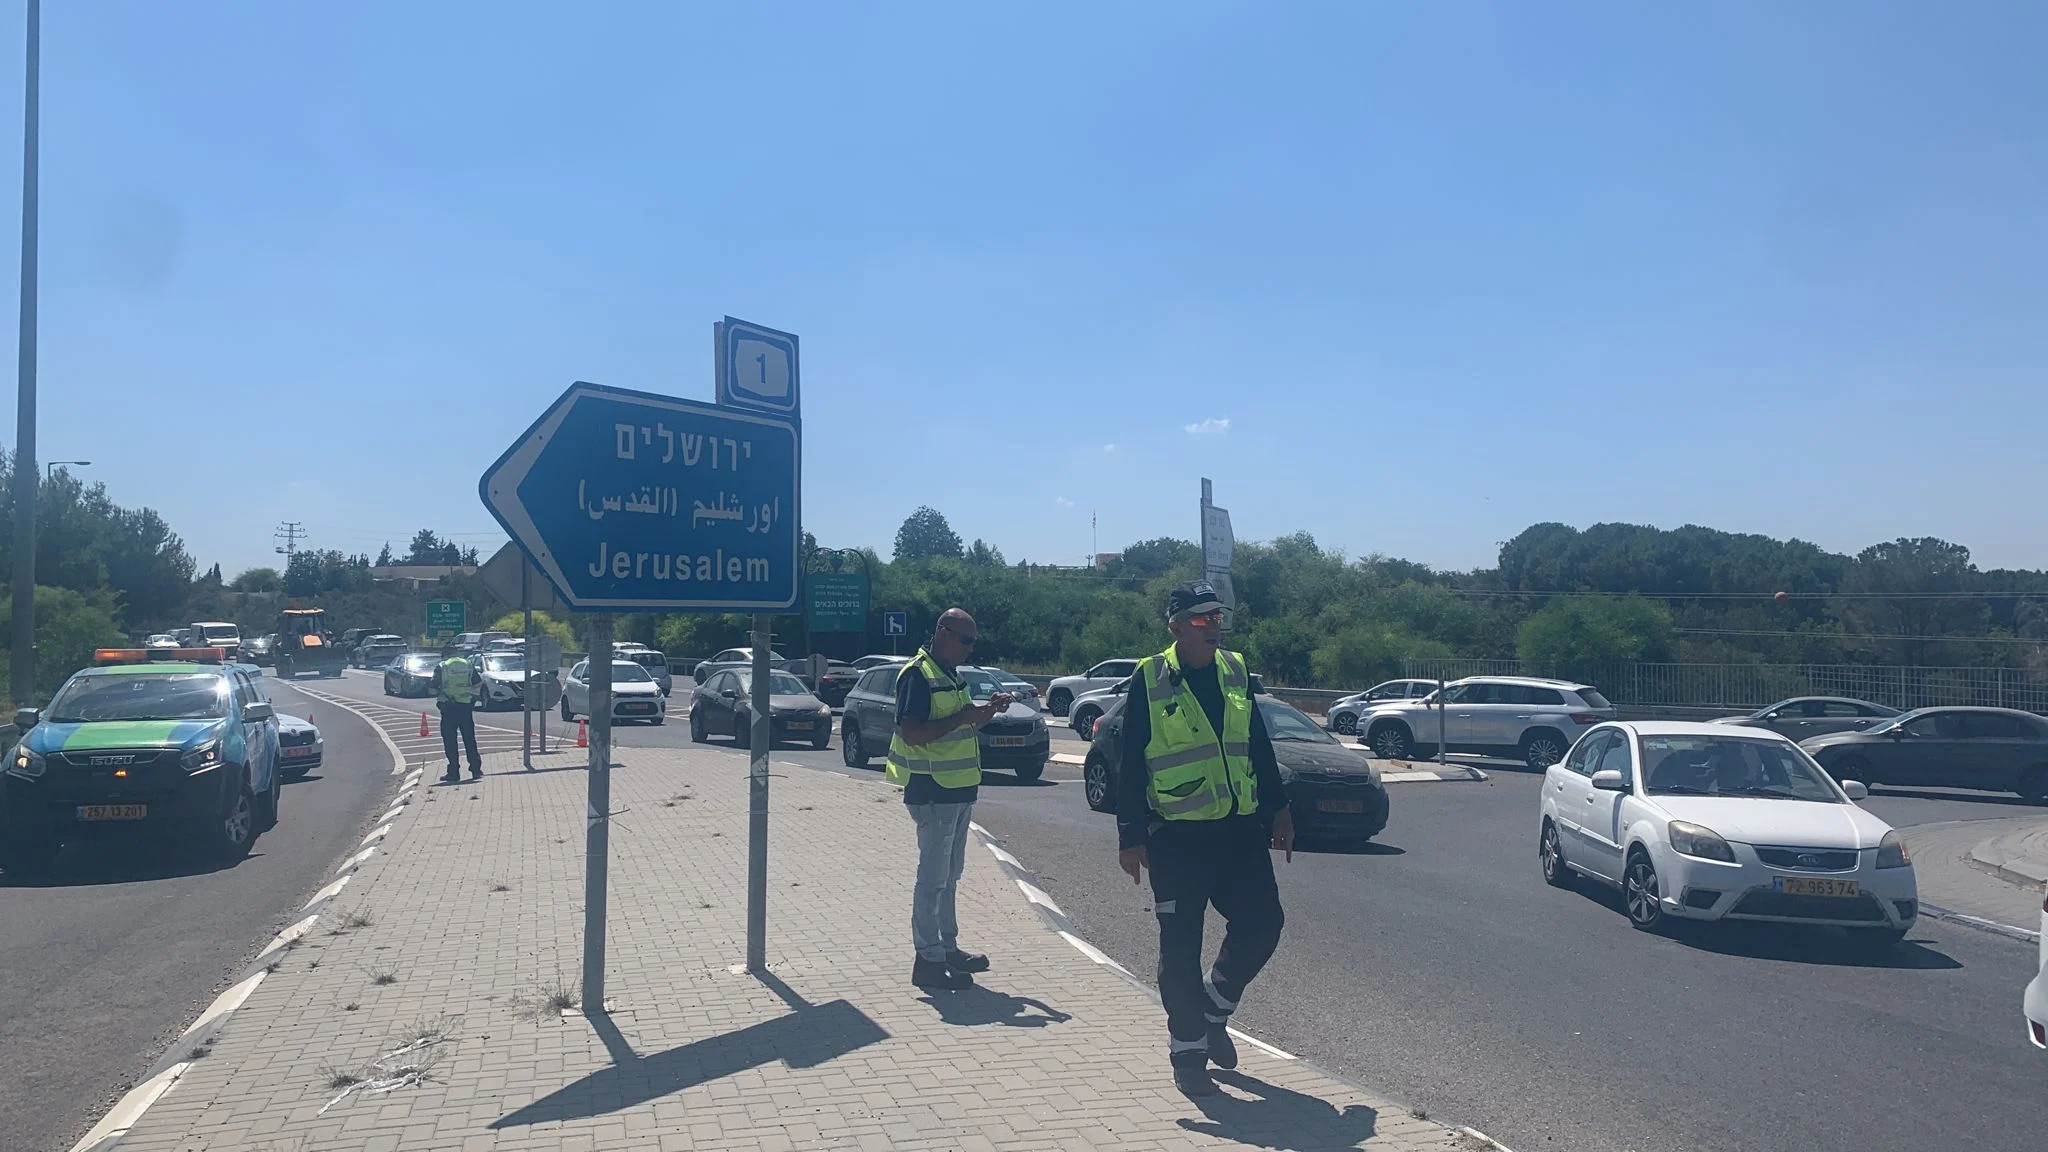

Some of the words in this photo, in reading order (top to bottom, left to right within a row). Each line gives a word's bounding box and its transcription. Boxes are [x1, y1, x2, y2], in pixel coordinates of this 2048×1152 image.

[755, 352, 766, 384] 1
[615, 422, 751, 472] ירושלים
[588, 542, 769, 582] Jerusalem
[89, 755, 135, 765] ISUZU
